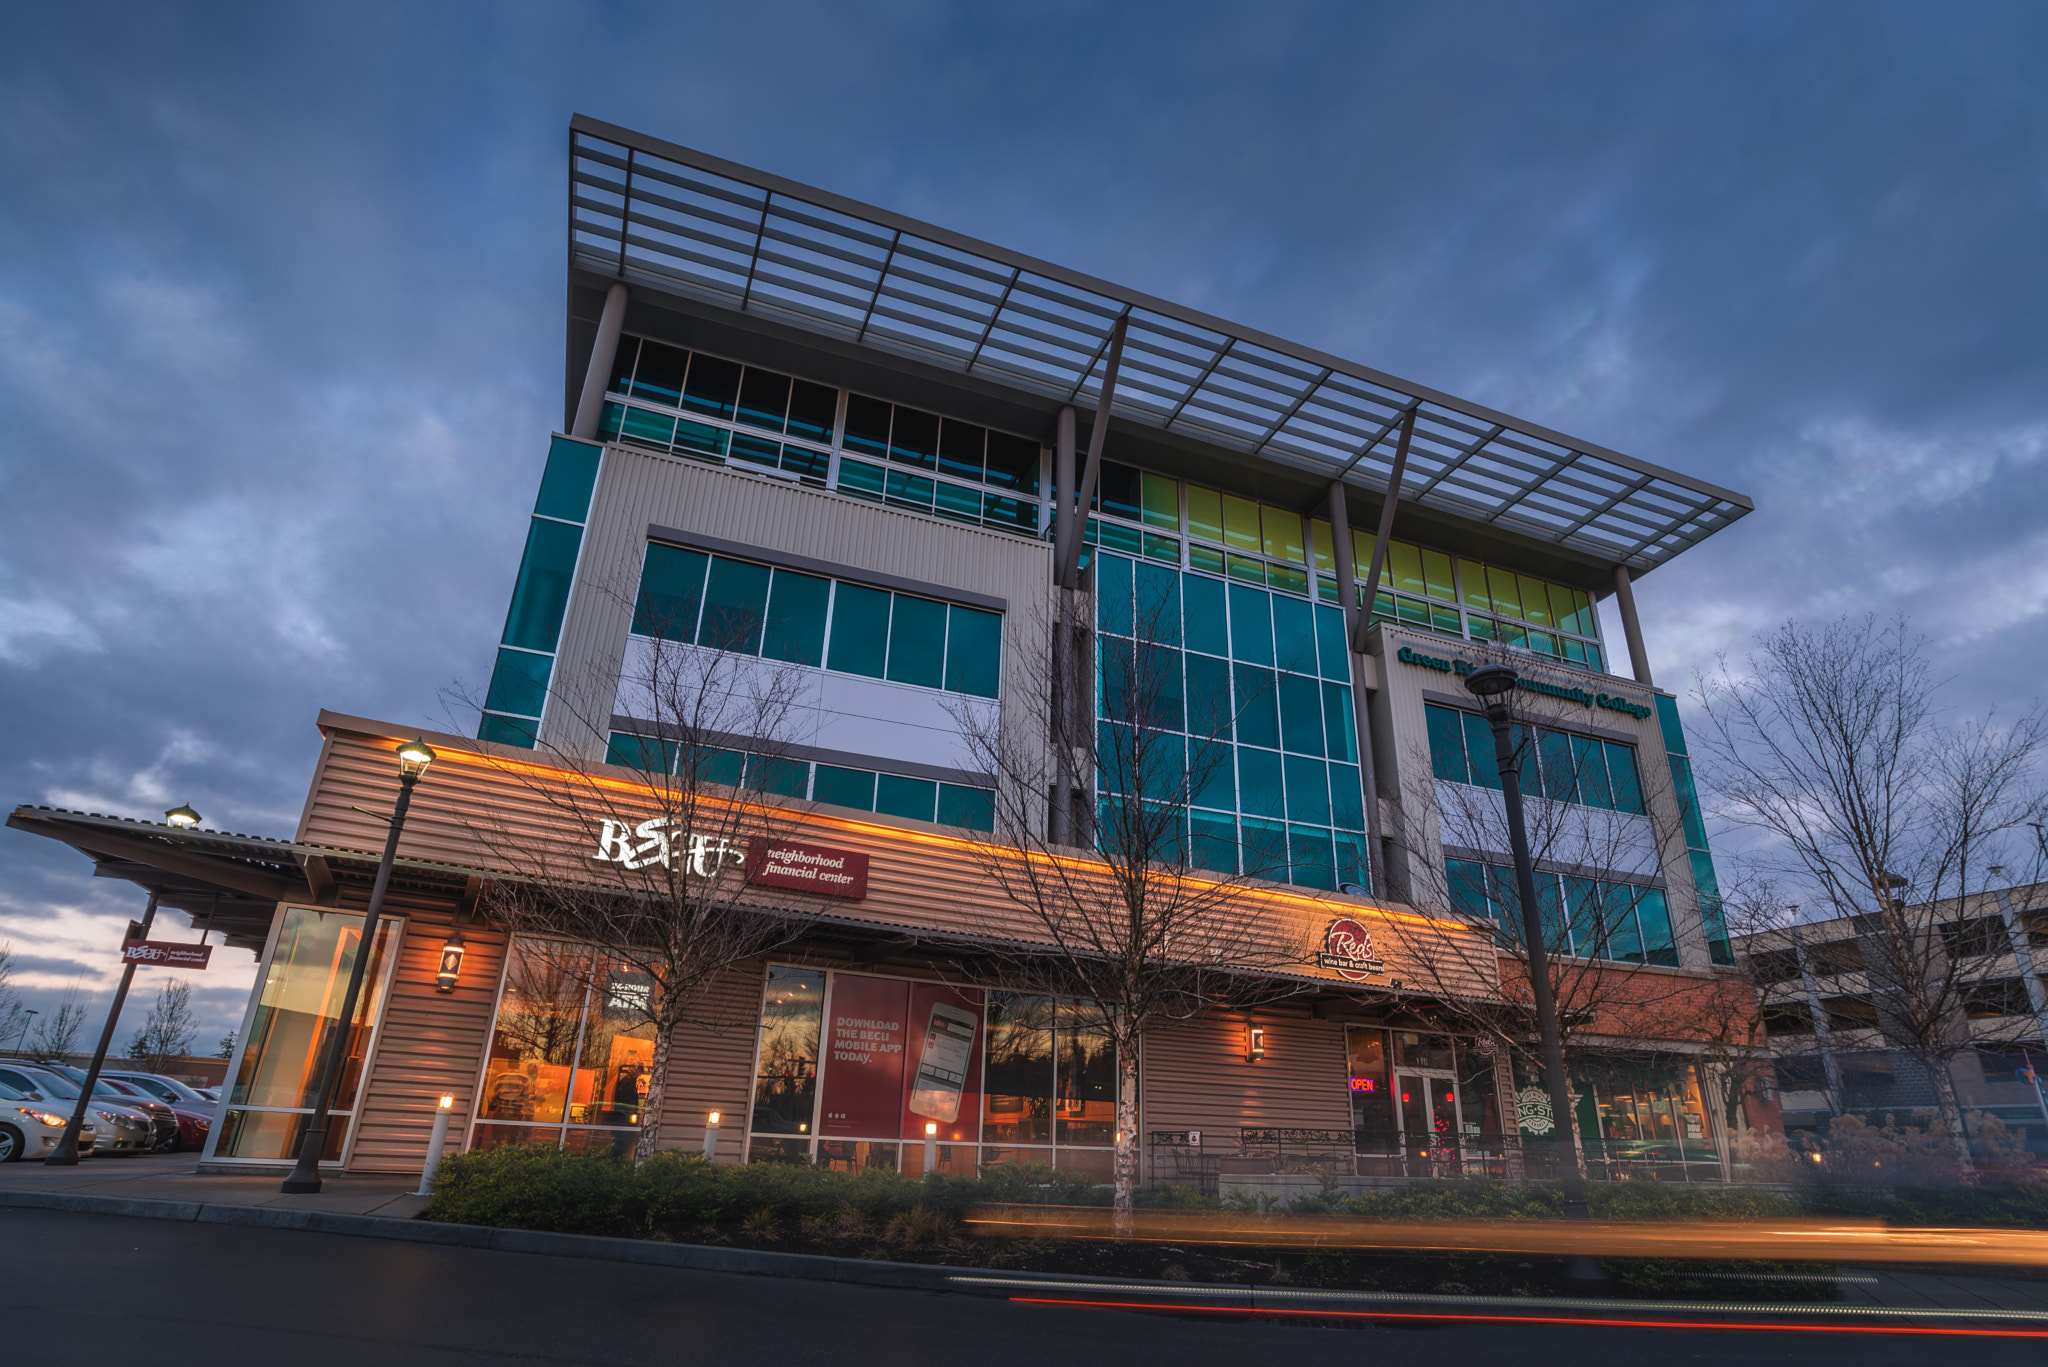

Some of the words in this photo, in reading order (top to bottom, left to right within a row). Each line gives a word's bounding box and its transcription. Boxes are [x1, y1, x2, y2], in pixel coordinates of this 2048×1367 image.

[1397, 646, 1452, 673] Green
[1516, 677, 1595, 709] ommunity
[1596, 692, 1652, 720] College
[767, 848, 845, 869] neighborhood
[763, 861, 817, 880] financial
[818, 872, 854, 885] center
[125, 945, 166, 960] BECU
[1324, 958, 1338, 966] wine
[1338, 959, 1348, 967] bar
[1354, 962, 1368, 970] craft
[1368, 963, 1384, 972] beers
[608, 993, 648, 1011] ATM
[837, 1017, 900, 1031] DOWNLOAD
[836, 1028, 857, 1039] THE
[860, 1030, 890, 1042] BECU
[834, 1040, 878, 1052] MOBILE
[879, 1043, 902, 1054] APP
[1350, 1079, 1373, 1091] OPEN
